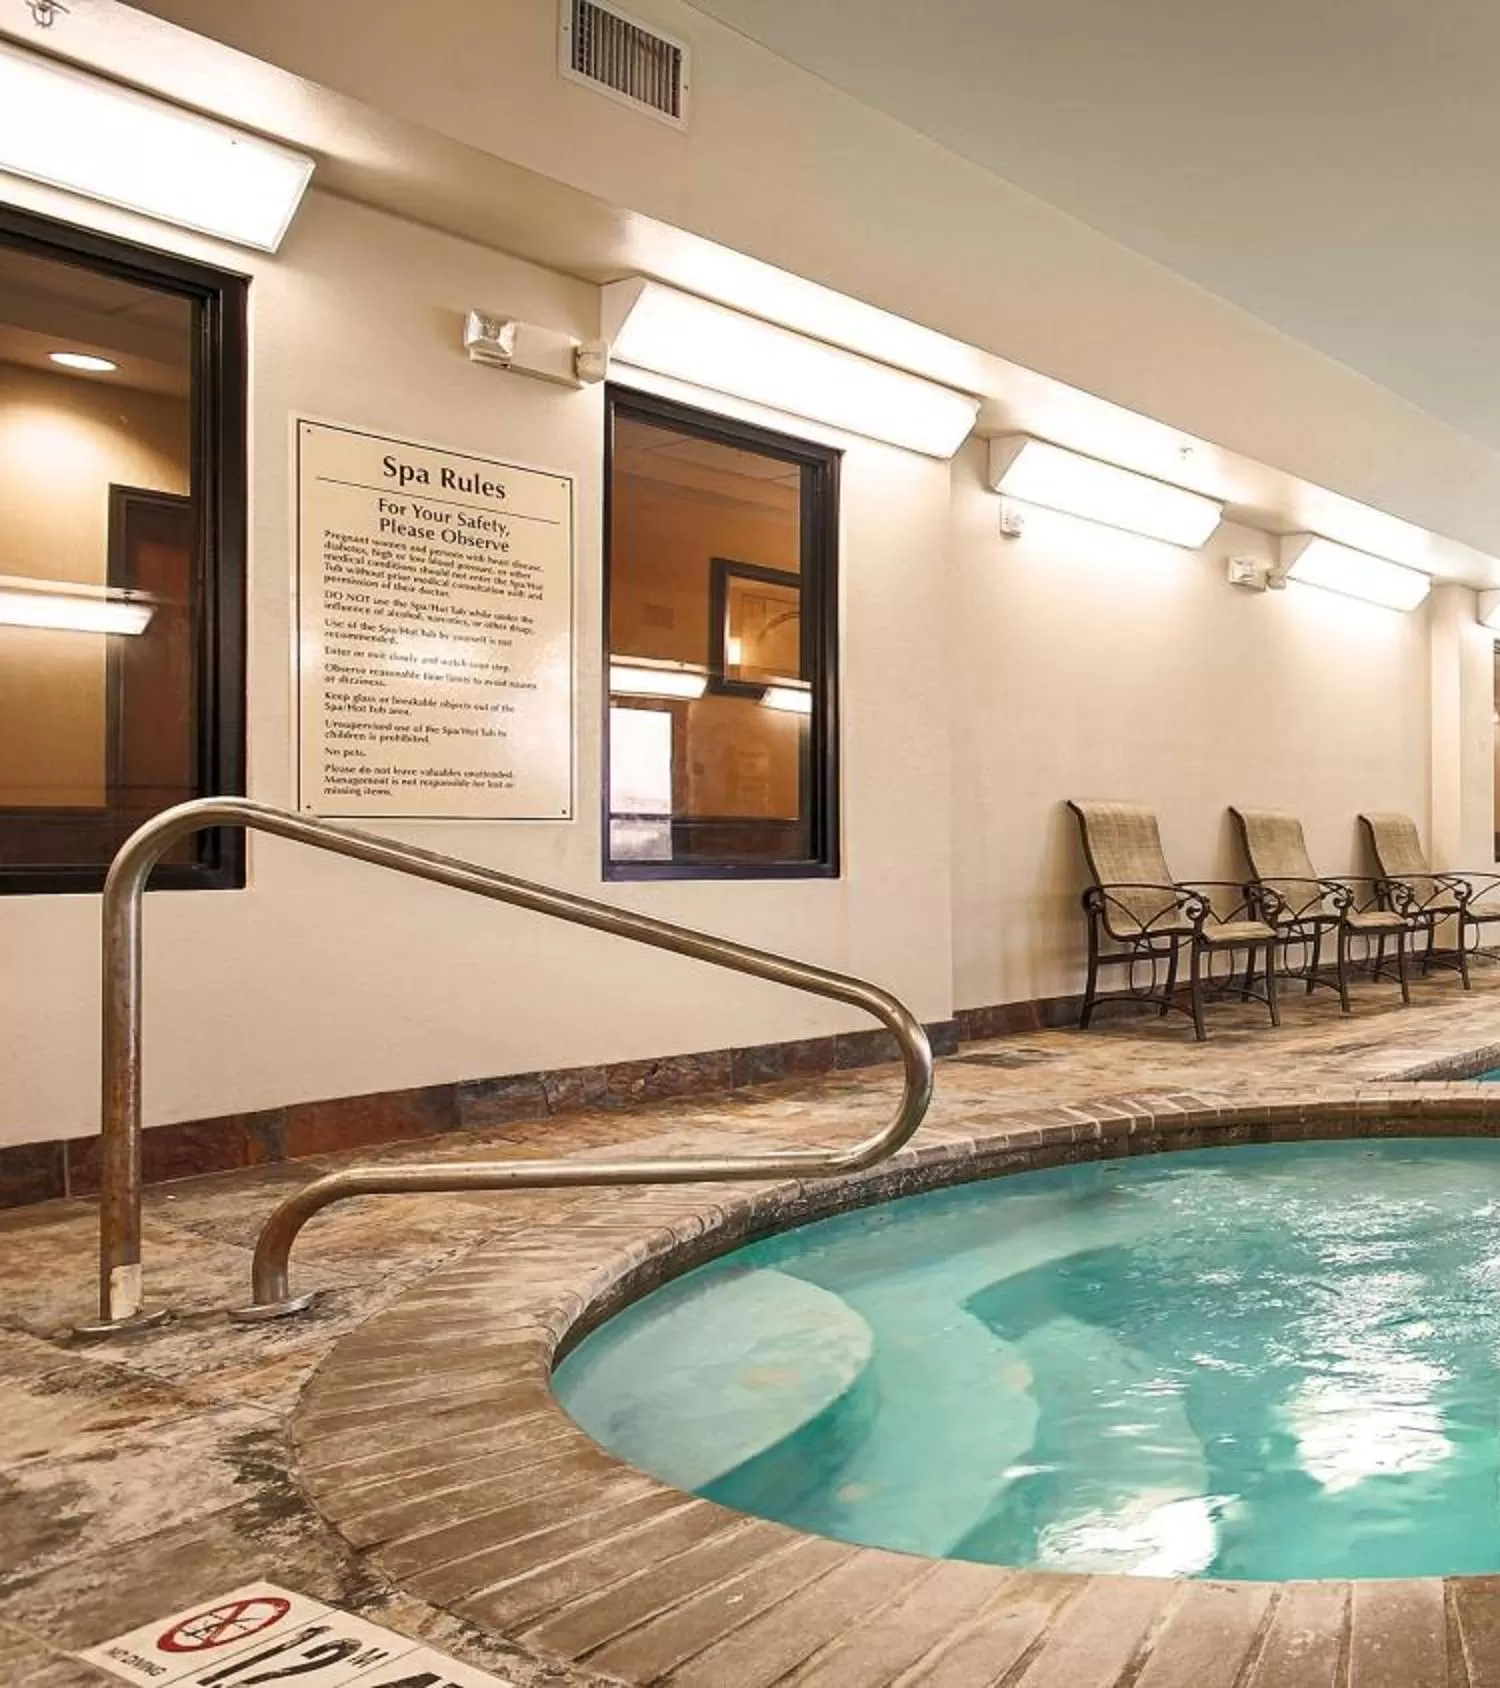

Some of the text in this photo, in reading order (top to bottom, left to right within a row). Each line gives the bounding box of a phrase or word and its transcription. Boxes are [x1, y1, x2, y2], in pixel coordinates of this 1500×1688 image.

[383, 455, 507, 499] Spa Rules
[378, 498, 512, 538] For Your Safety,
[379, 518, 510, 553] Please Observe
[372, 546, 392, 559] high
[395, 552, 405, 560] or
[409, 544, 426, 553] and
[324, 551, 364, 564] medical
[451, 570, 466, 579] not
[325, 561, 342, 572] Tub
[345, 565, 384, 578] without
[527, 592, 543, 600] and
[381, 581, 390, 589] of
[325, 589, 343, 599] DO
[346, 592, 370, 603] NOT
[360, 621, 376, 631] the
[325, 690, 350, 702] Keep
[353, 692, 375, 703] glass
[490, 703, 500, 711] of
[501, 703, 515, 712] the
[369, 704, 386, 713] Tub
[325, 729, 366, 740] children
[325, 747, 341, 755] No
[325, 764, 356, 773] Please
[359, 765, 372, 774] do
[374, 766, 390, 774] not
[324, 774, 389, 786] Management
[402, 777, 416, 785] not
[119, 1654, 167, 1677] DIVING
